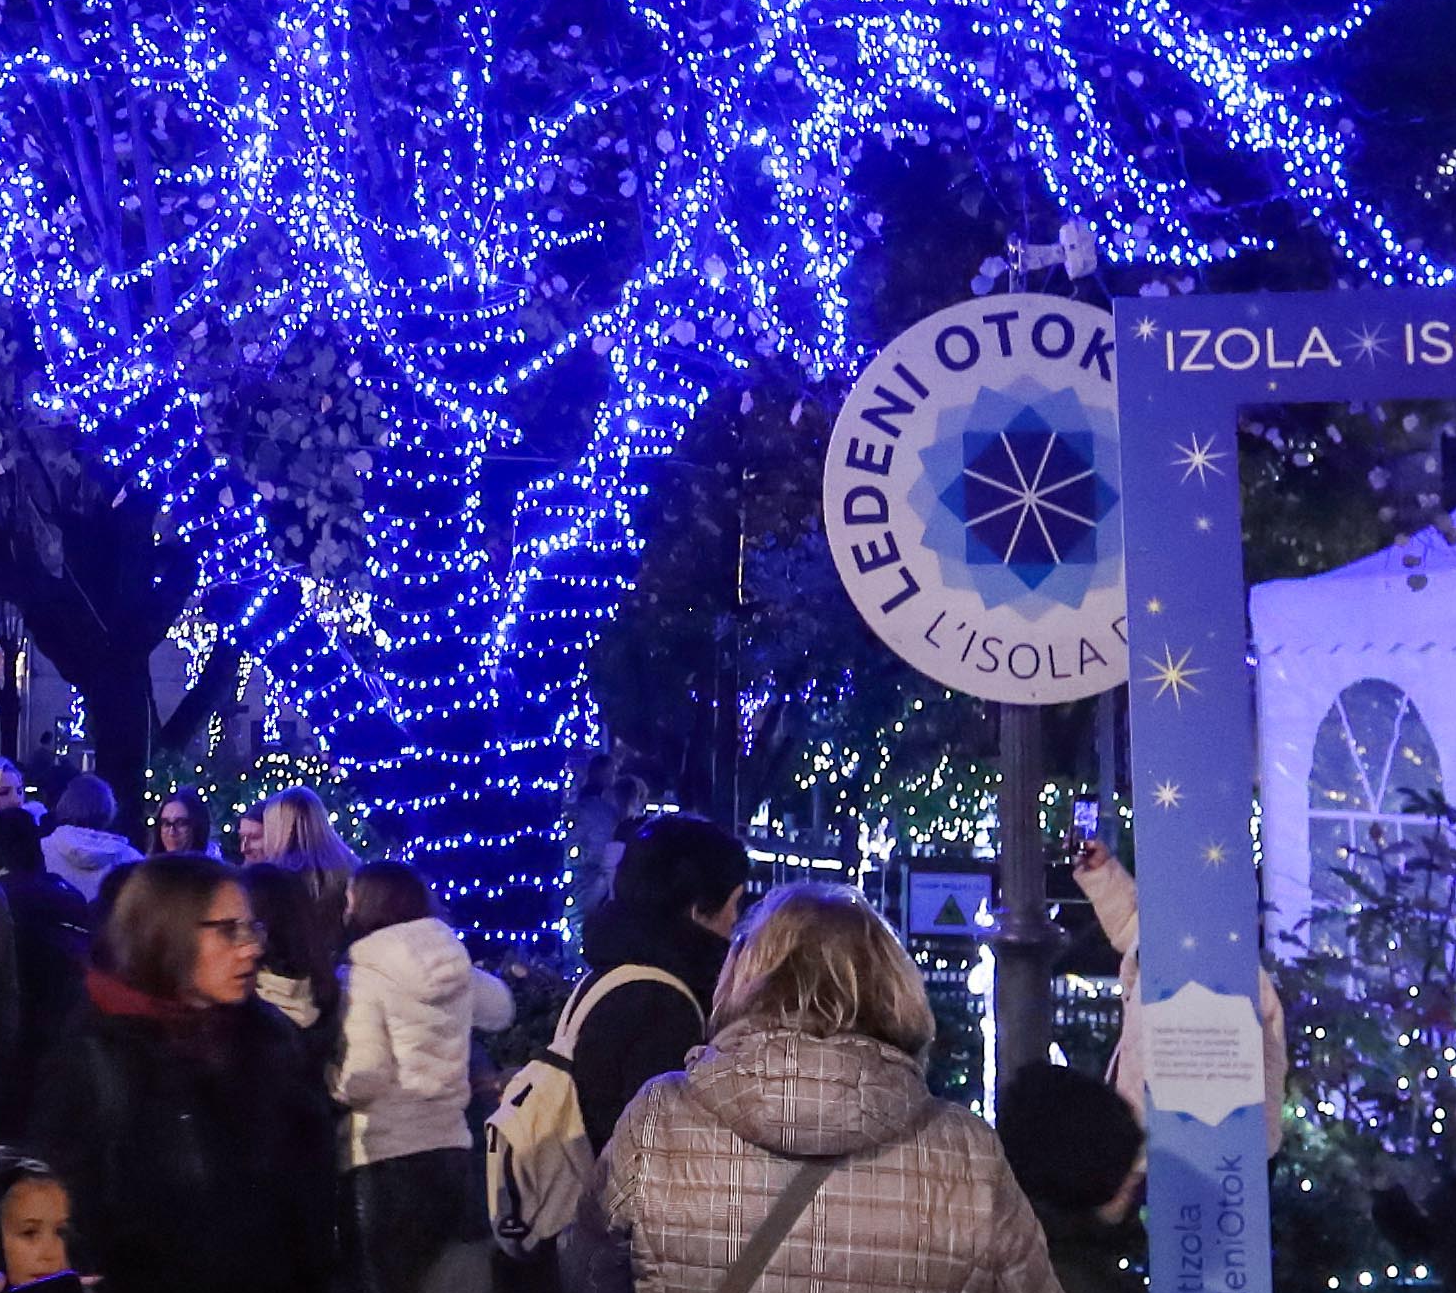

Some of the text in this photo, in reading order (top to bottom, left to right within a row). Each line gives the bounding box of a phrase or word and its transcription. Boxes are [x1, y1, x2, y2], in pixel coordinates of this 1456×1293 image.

[1166, 326, 1342, 372] IZOLA
[843, 310, 1116, 615] LEDENI OTOK
[924, 610, 1108, 680] L'ISOLA
